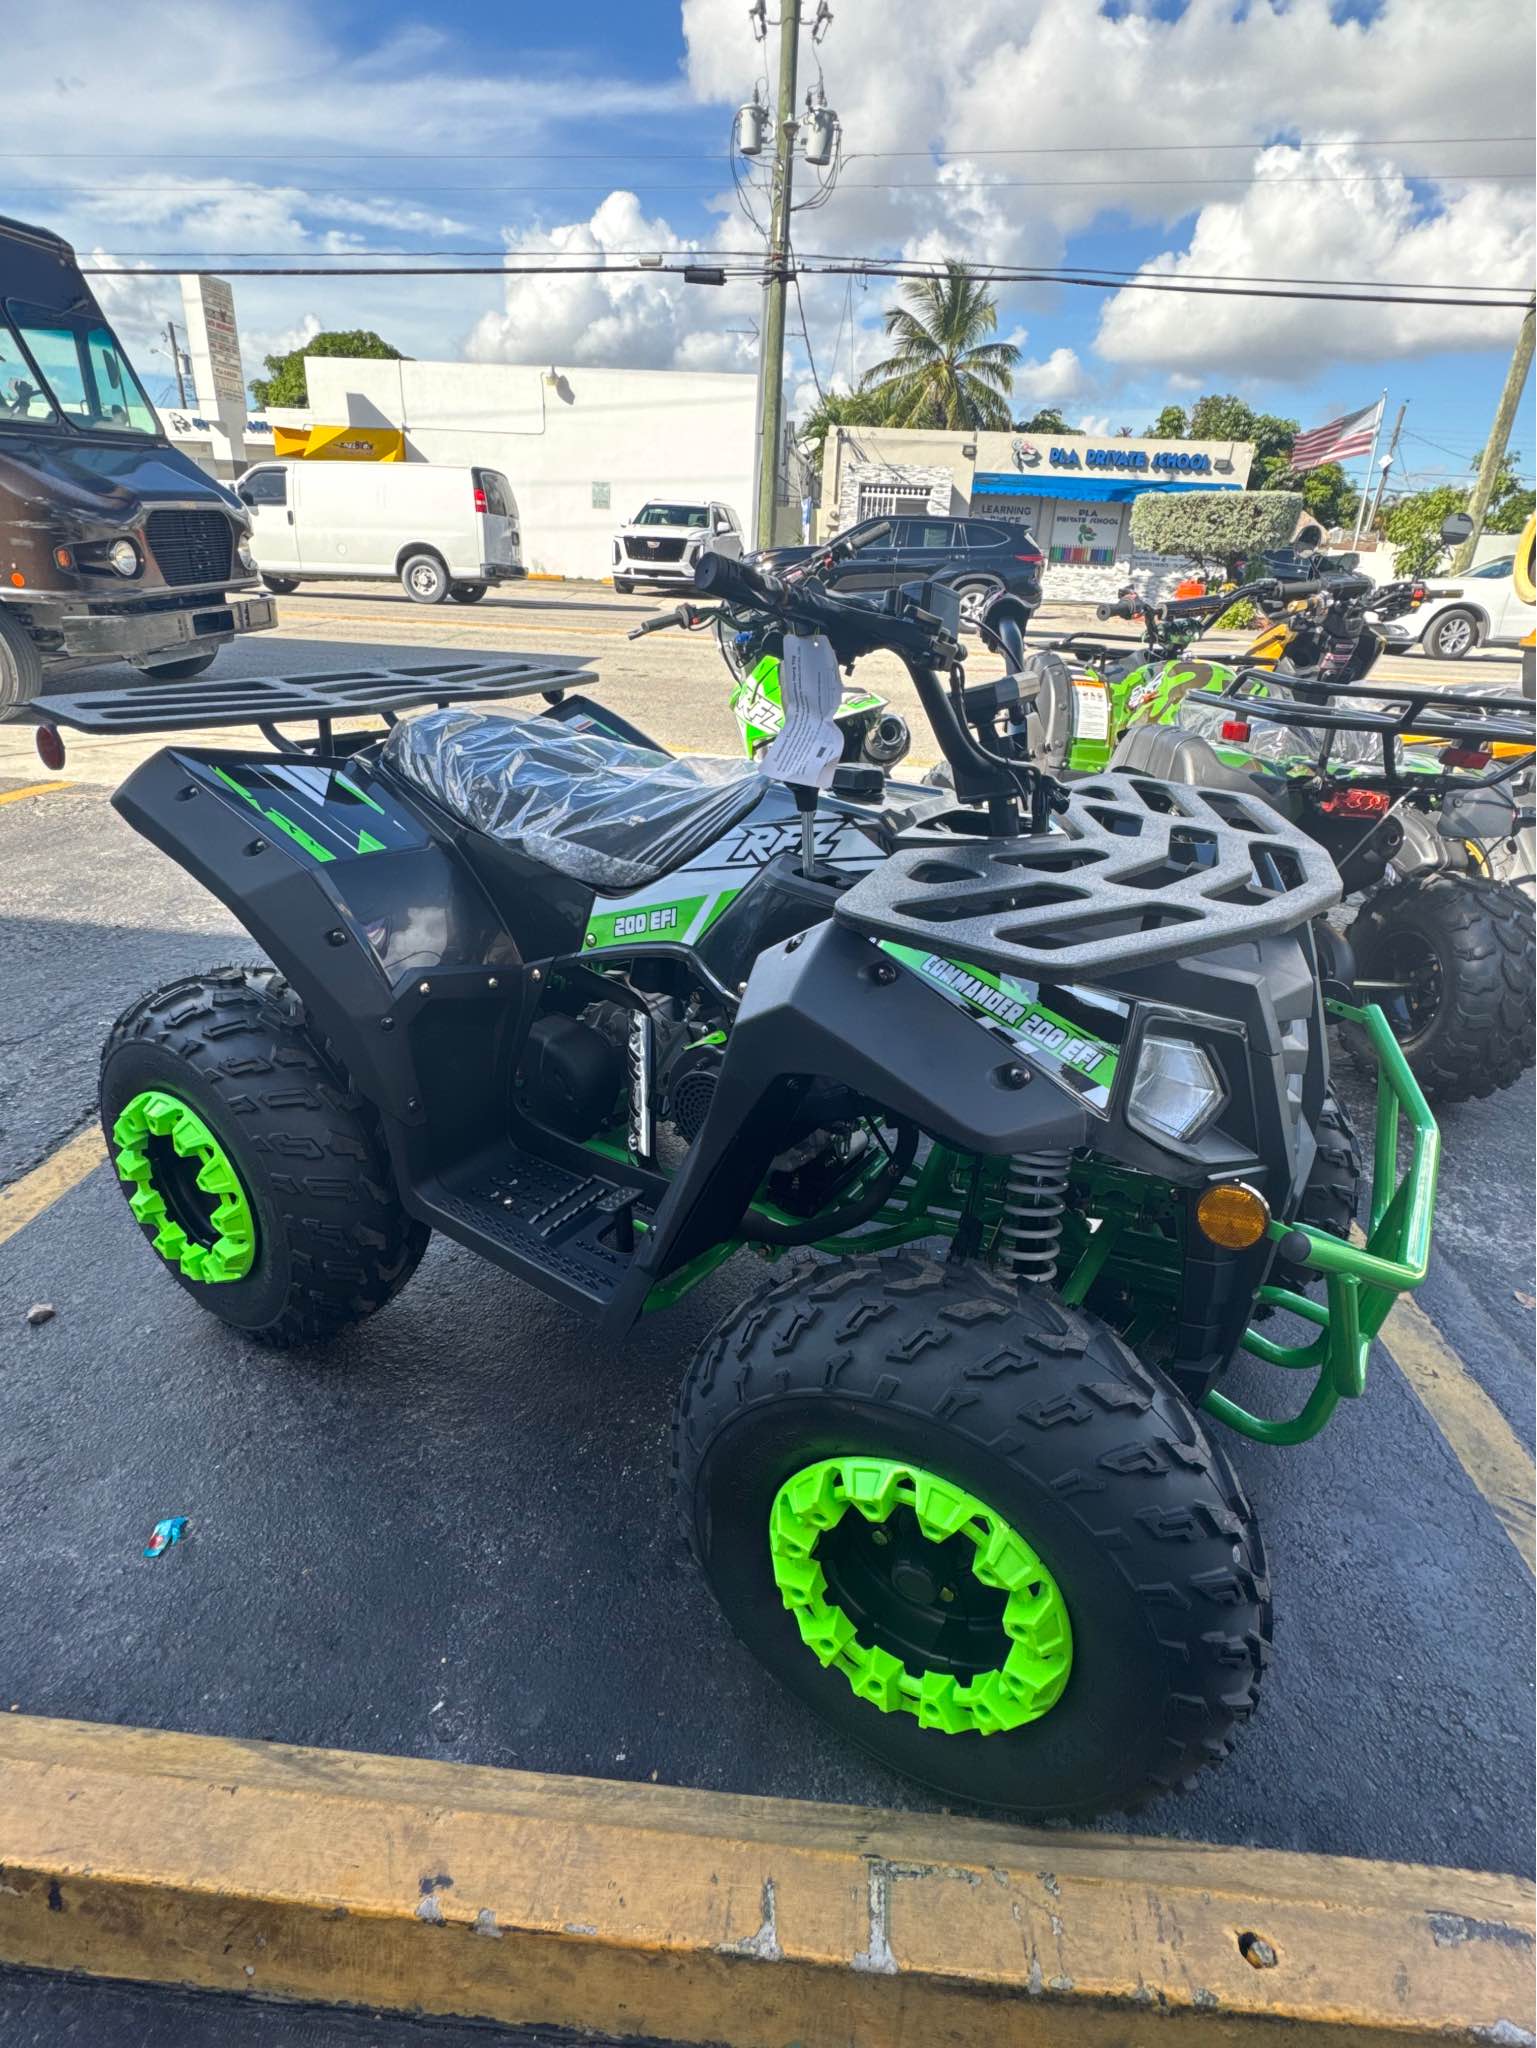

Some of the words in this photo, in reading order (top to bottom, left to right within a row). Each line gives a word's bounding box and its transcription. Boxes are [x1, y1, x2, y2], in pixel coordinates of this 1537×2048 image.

[1050, 448, 1080, 466] PLA
[1086, 449, 1149, 468] PRIVATE
[1151, 452, 1211, 471] SCHOOL
[982, 504, 1032, 516] LEARNING
[1078, 509, 1098, 517] PLA
[614, 912, 647, 938] 200
[649, 907, 678, 932] EFI
[920, 953, 1026, 1025] COMMANDER
[1020, 1013, 1068, 1050] 200
[1059, 1036, 1106, 1074] EFI
